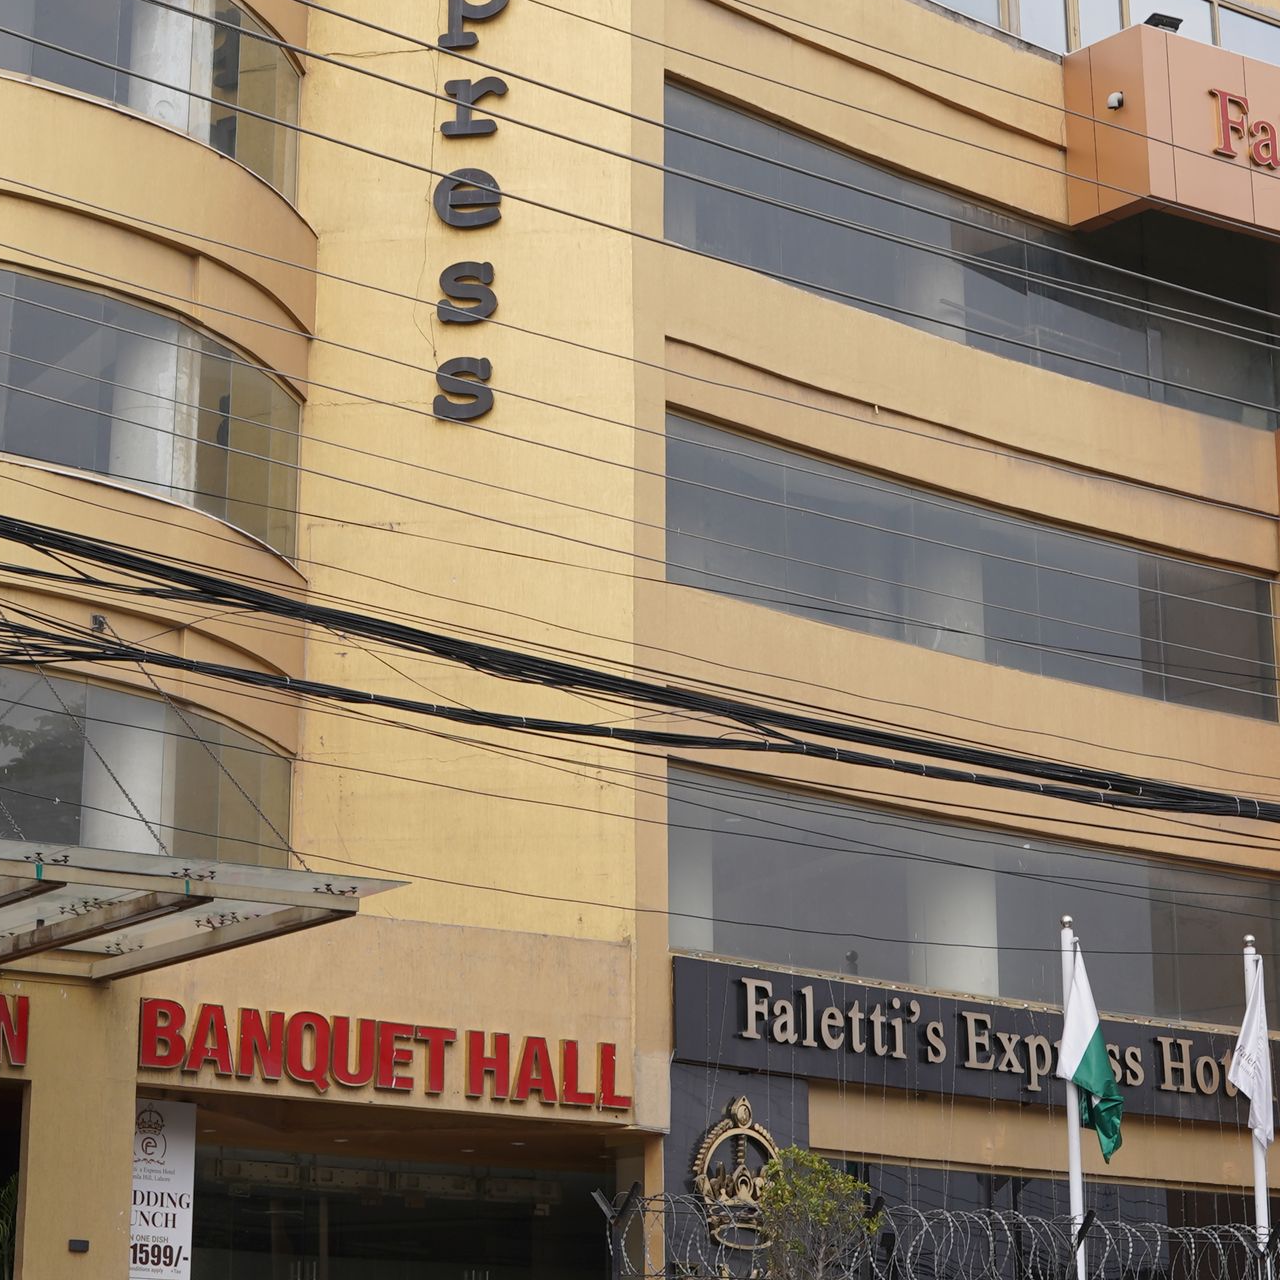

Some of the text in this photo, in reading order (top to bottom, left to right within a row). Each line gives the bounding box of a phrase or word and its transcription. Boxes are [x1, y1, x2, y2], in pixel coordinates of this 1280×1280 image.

[740, 976, 1277, 1102] Faletti's Expss Hot
[138, 997, 633, 1111] BANQUET HALL
[133, 1189, 191, 1210] DDING
[130, 1210, 177, 1229] UNCH
[135, 1234, 151, 1243] ONE
[151, 1235, 169, 1244] DISH
[130, 1243, 189, 1268] 1599/-
